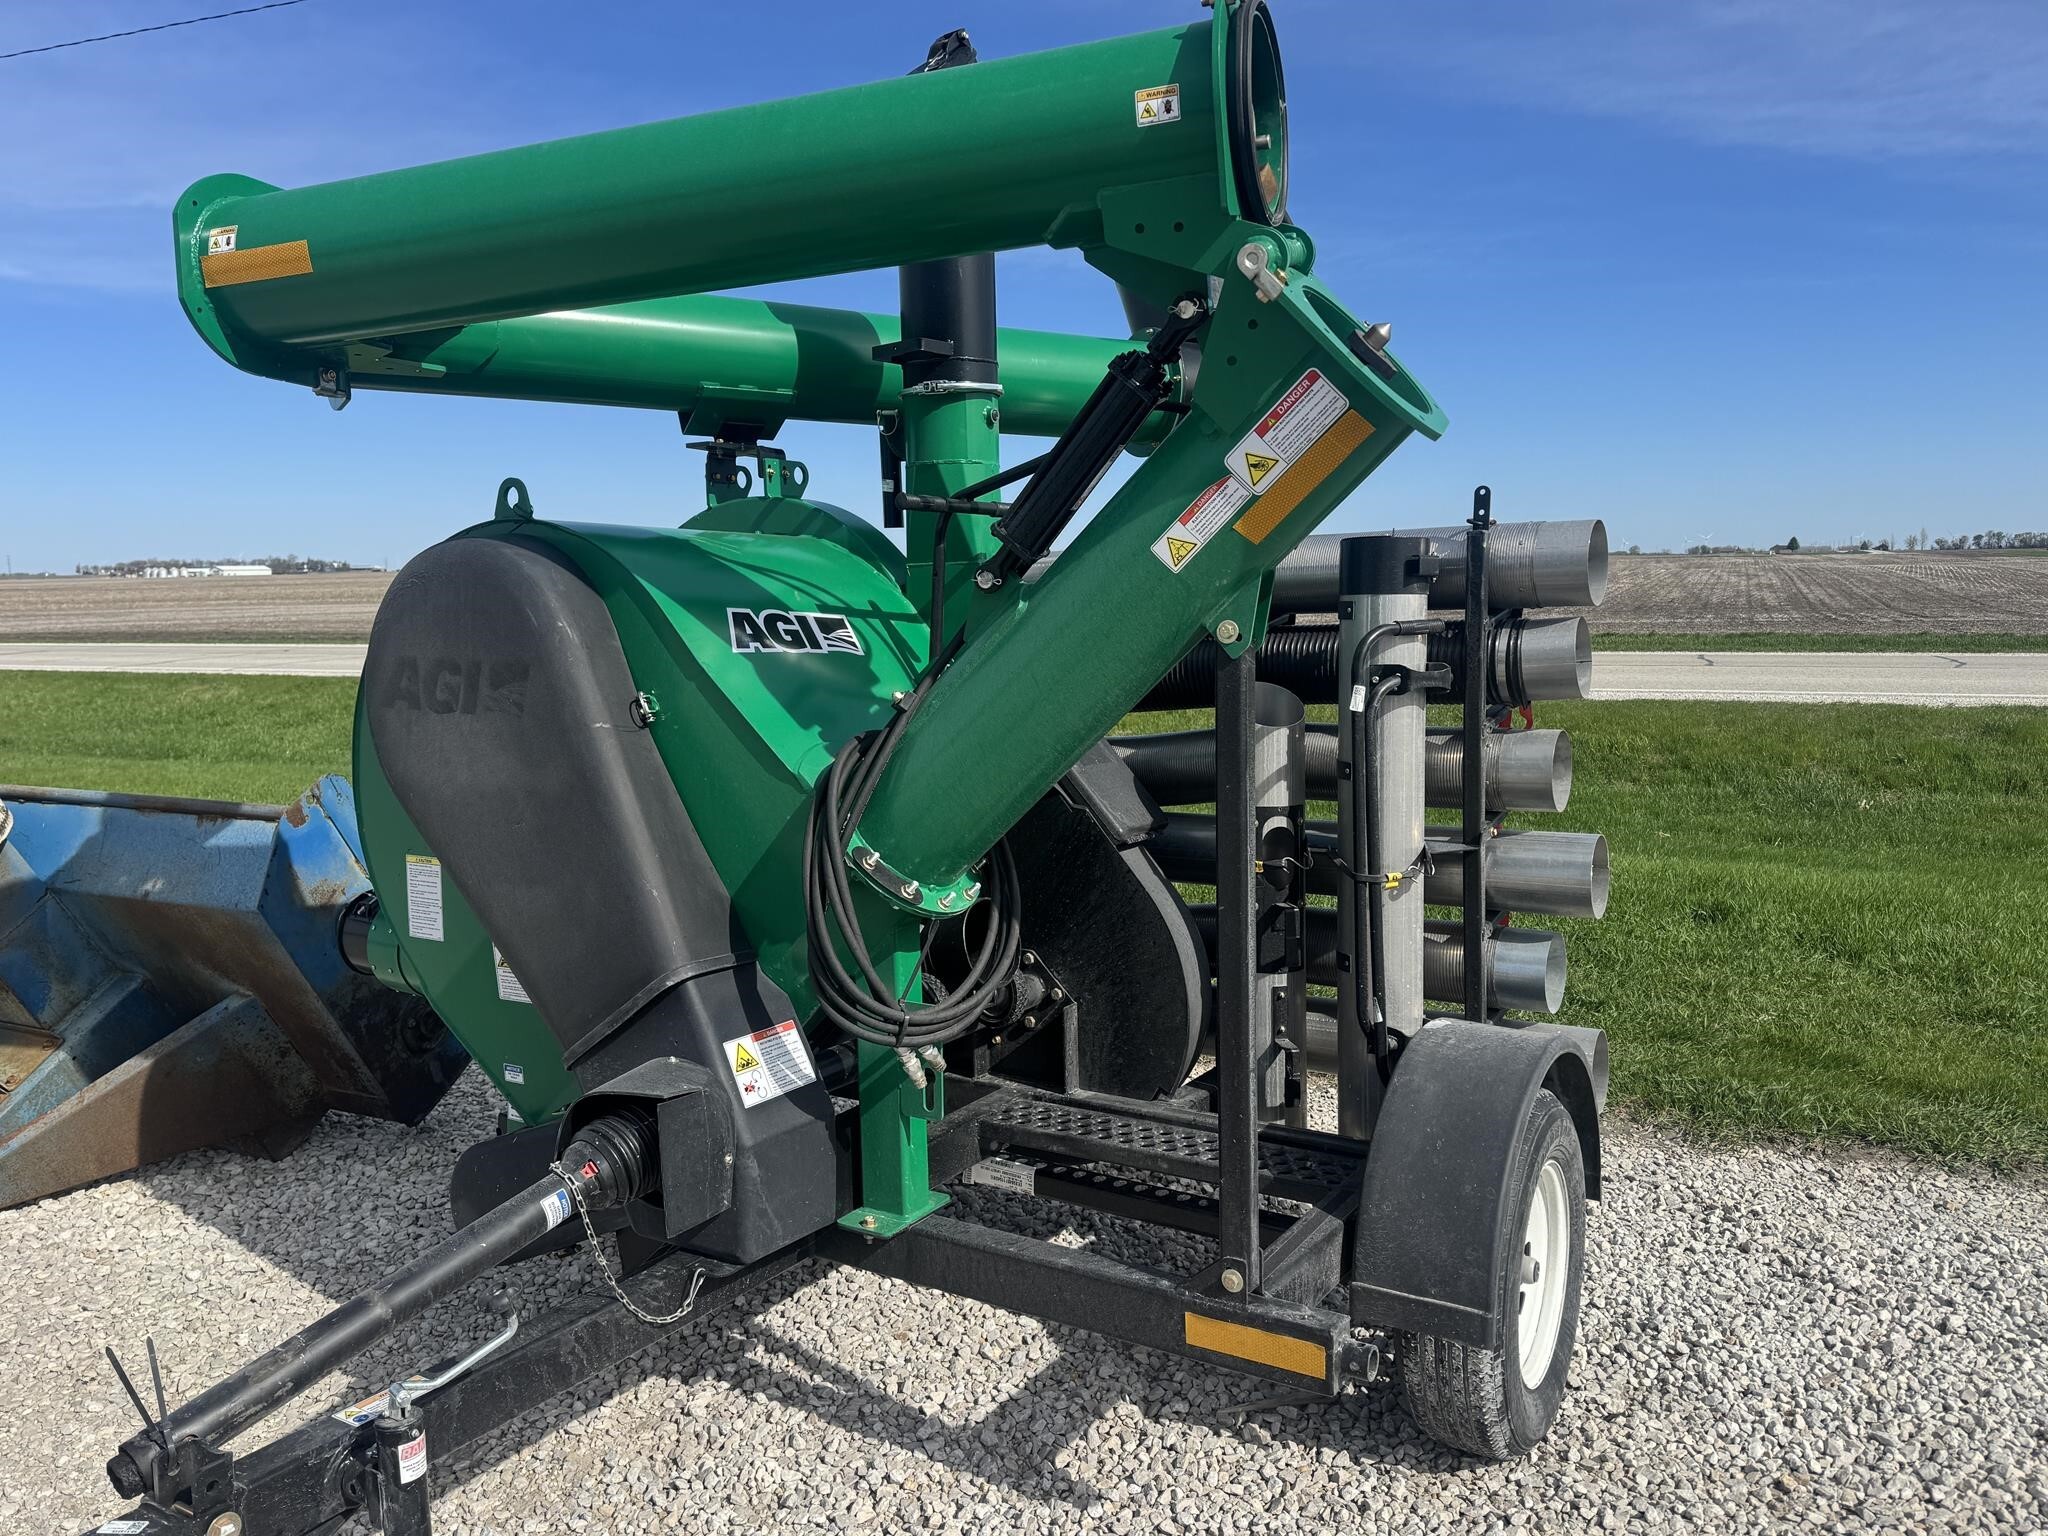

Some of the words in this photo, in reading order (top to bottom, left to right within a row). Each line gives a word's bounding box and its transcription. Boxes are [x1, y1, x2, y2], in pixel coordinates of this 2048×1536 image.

[1145, 87, 1176, 98] WARNING
[1276, 379, 1311, 414] DANGER
[1197, 485, 1219, 507] DANGER
[728, 608, 826, 652] AGI
[382, 655, 482, 715] AGI
